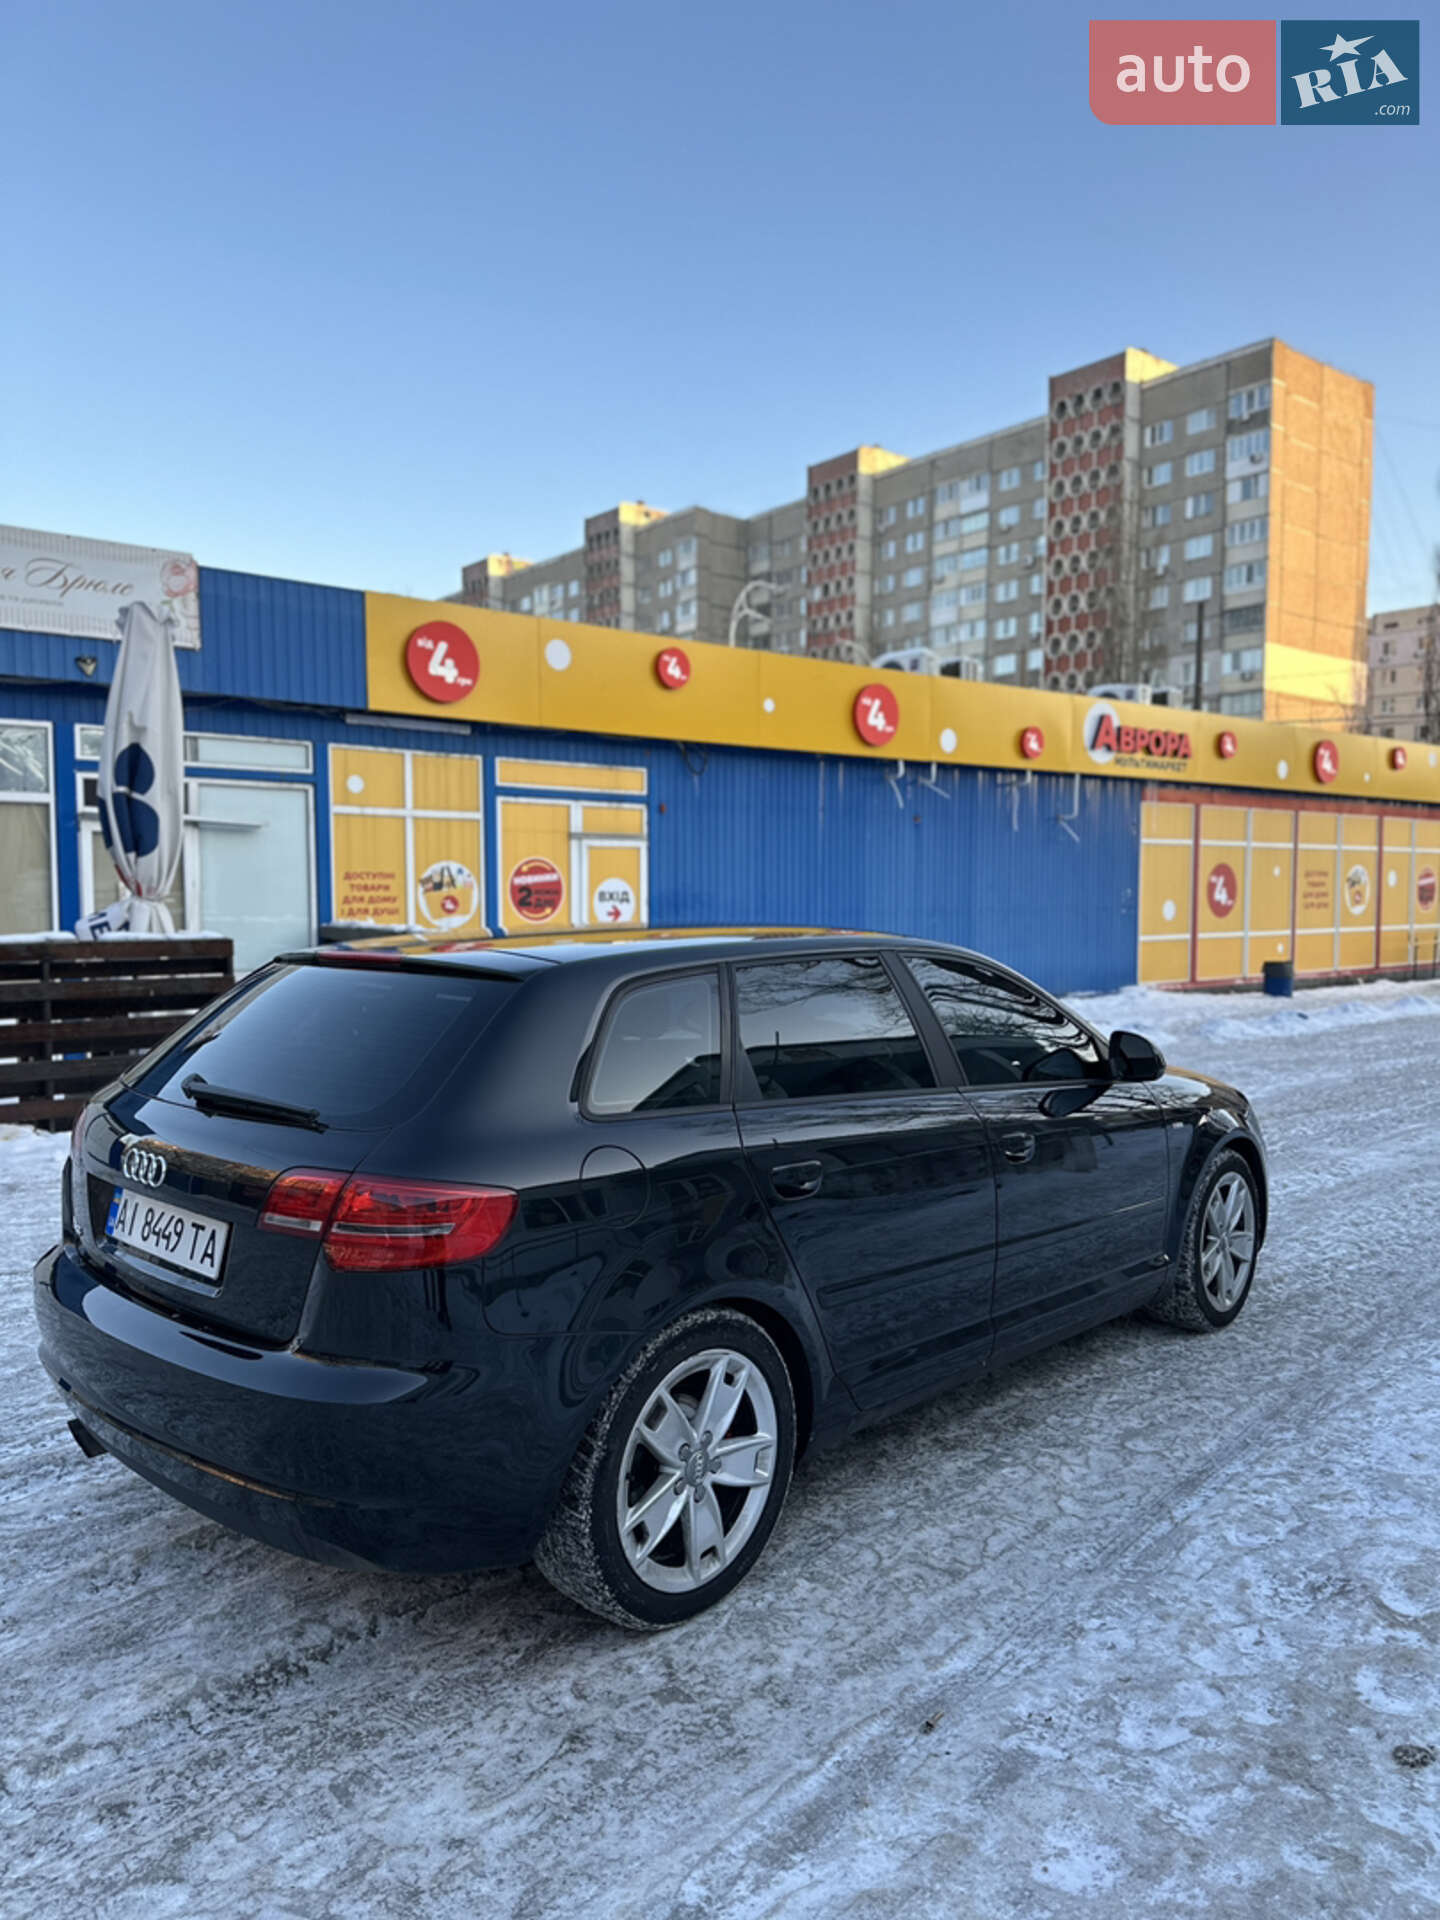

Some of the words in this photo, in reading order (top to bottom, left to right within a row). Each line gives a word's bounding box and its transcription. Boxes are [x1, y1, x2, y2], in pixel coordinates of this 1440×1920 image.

[428, 640, 459, 684] 4
[867, 698, 886, 732] 4
[518, 886, 533, 907] 2
[598, 890, 630, 905] ВХІД
[1213, 875, 1228, 905] 4
[115, 1198, 139, 1237] AI
[141, 1207, 185, 1253] 8449
[190, 1221, 217, 1268] TA
